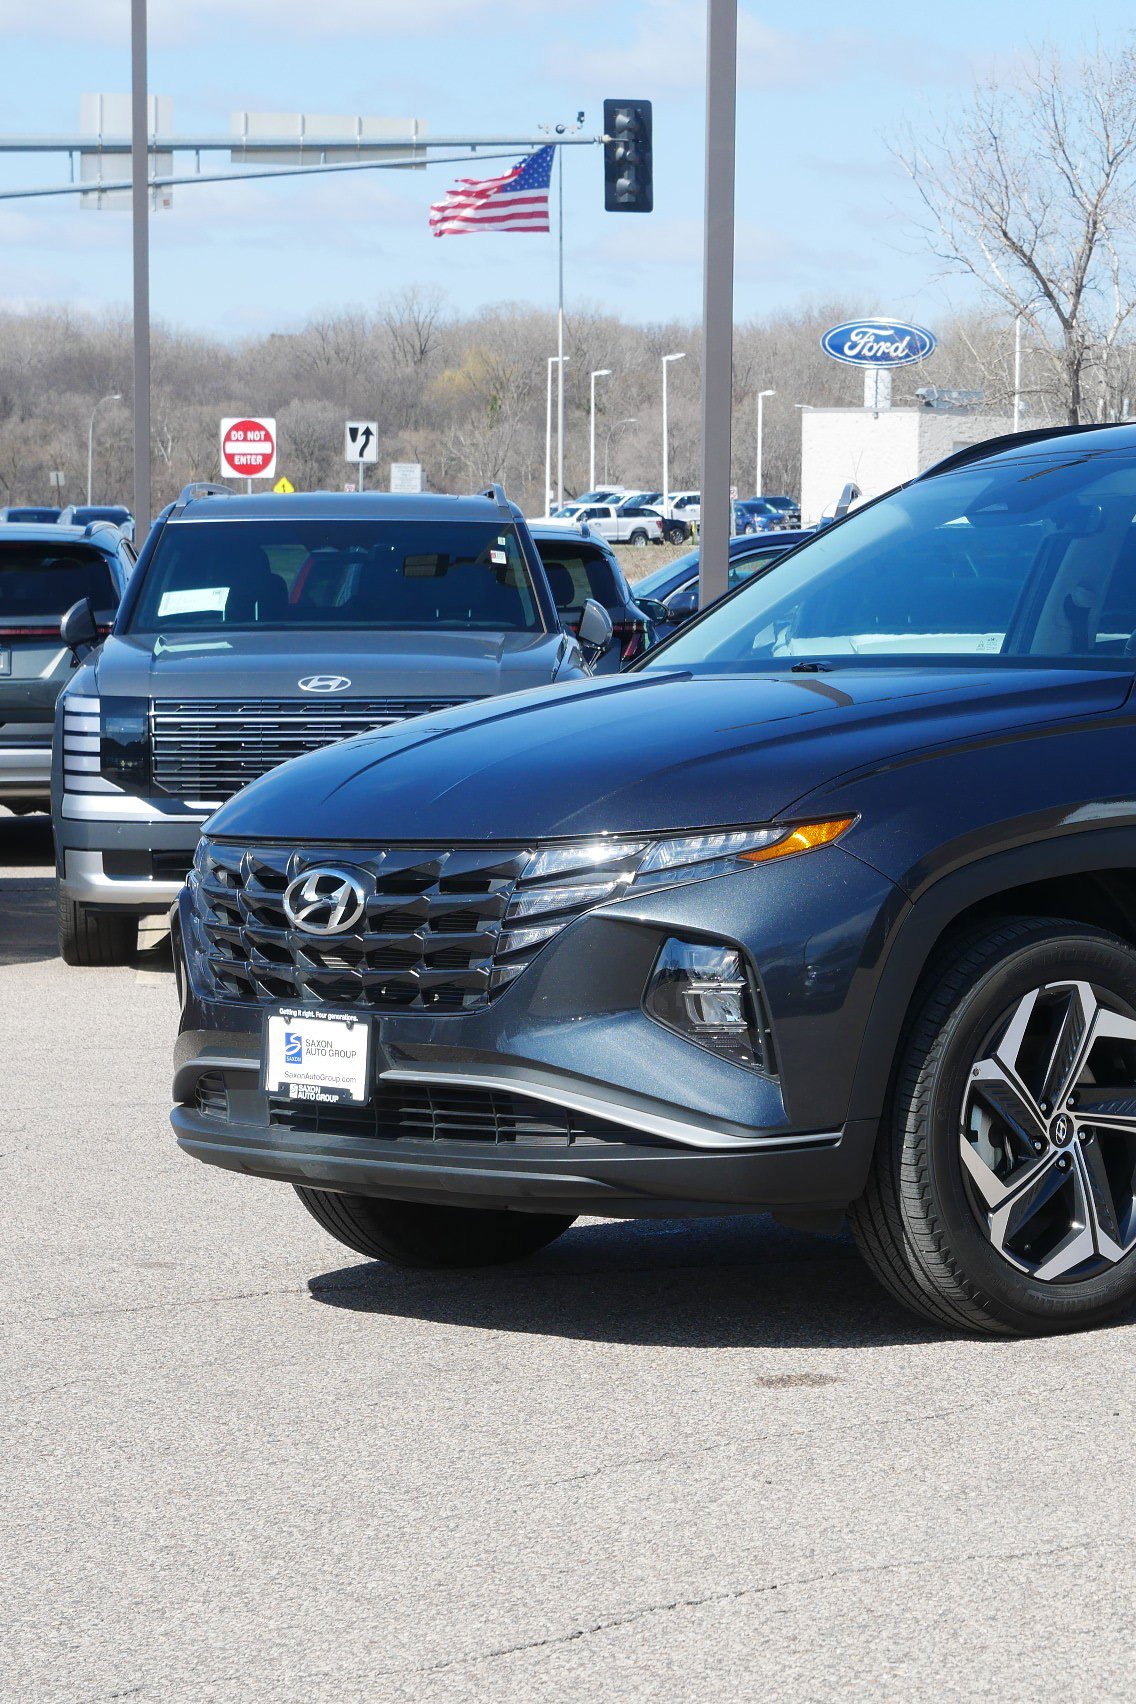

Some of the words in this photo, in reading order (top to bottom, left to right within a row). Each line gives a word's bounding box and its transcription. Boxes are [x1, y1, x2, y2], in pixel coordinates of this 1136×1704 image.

[843, 327, 911, 358] Ford
[231, 430, 244, 441] DO
[247, 430, 266, 441] NOT
[234, 455, 263, 465] ENTER
[279, 1008, 297, 1017] Getting
[305, 1039, 333, 1048] SAXON
[305, 1048, 327, 1057] AUTO
[328, 1050, 357, 1058] GROUP
[284, 1071, 357, 1083] SaxonAutoGroup.com
[298, 1084, 321, 1093] SAXON
[298, 1091, 317, 1100] AUTO
[317, 1093, 339, 1102] GROUP
